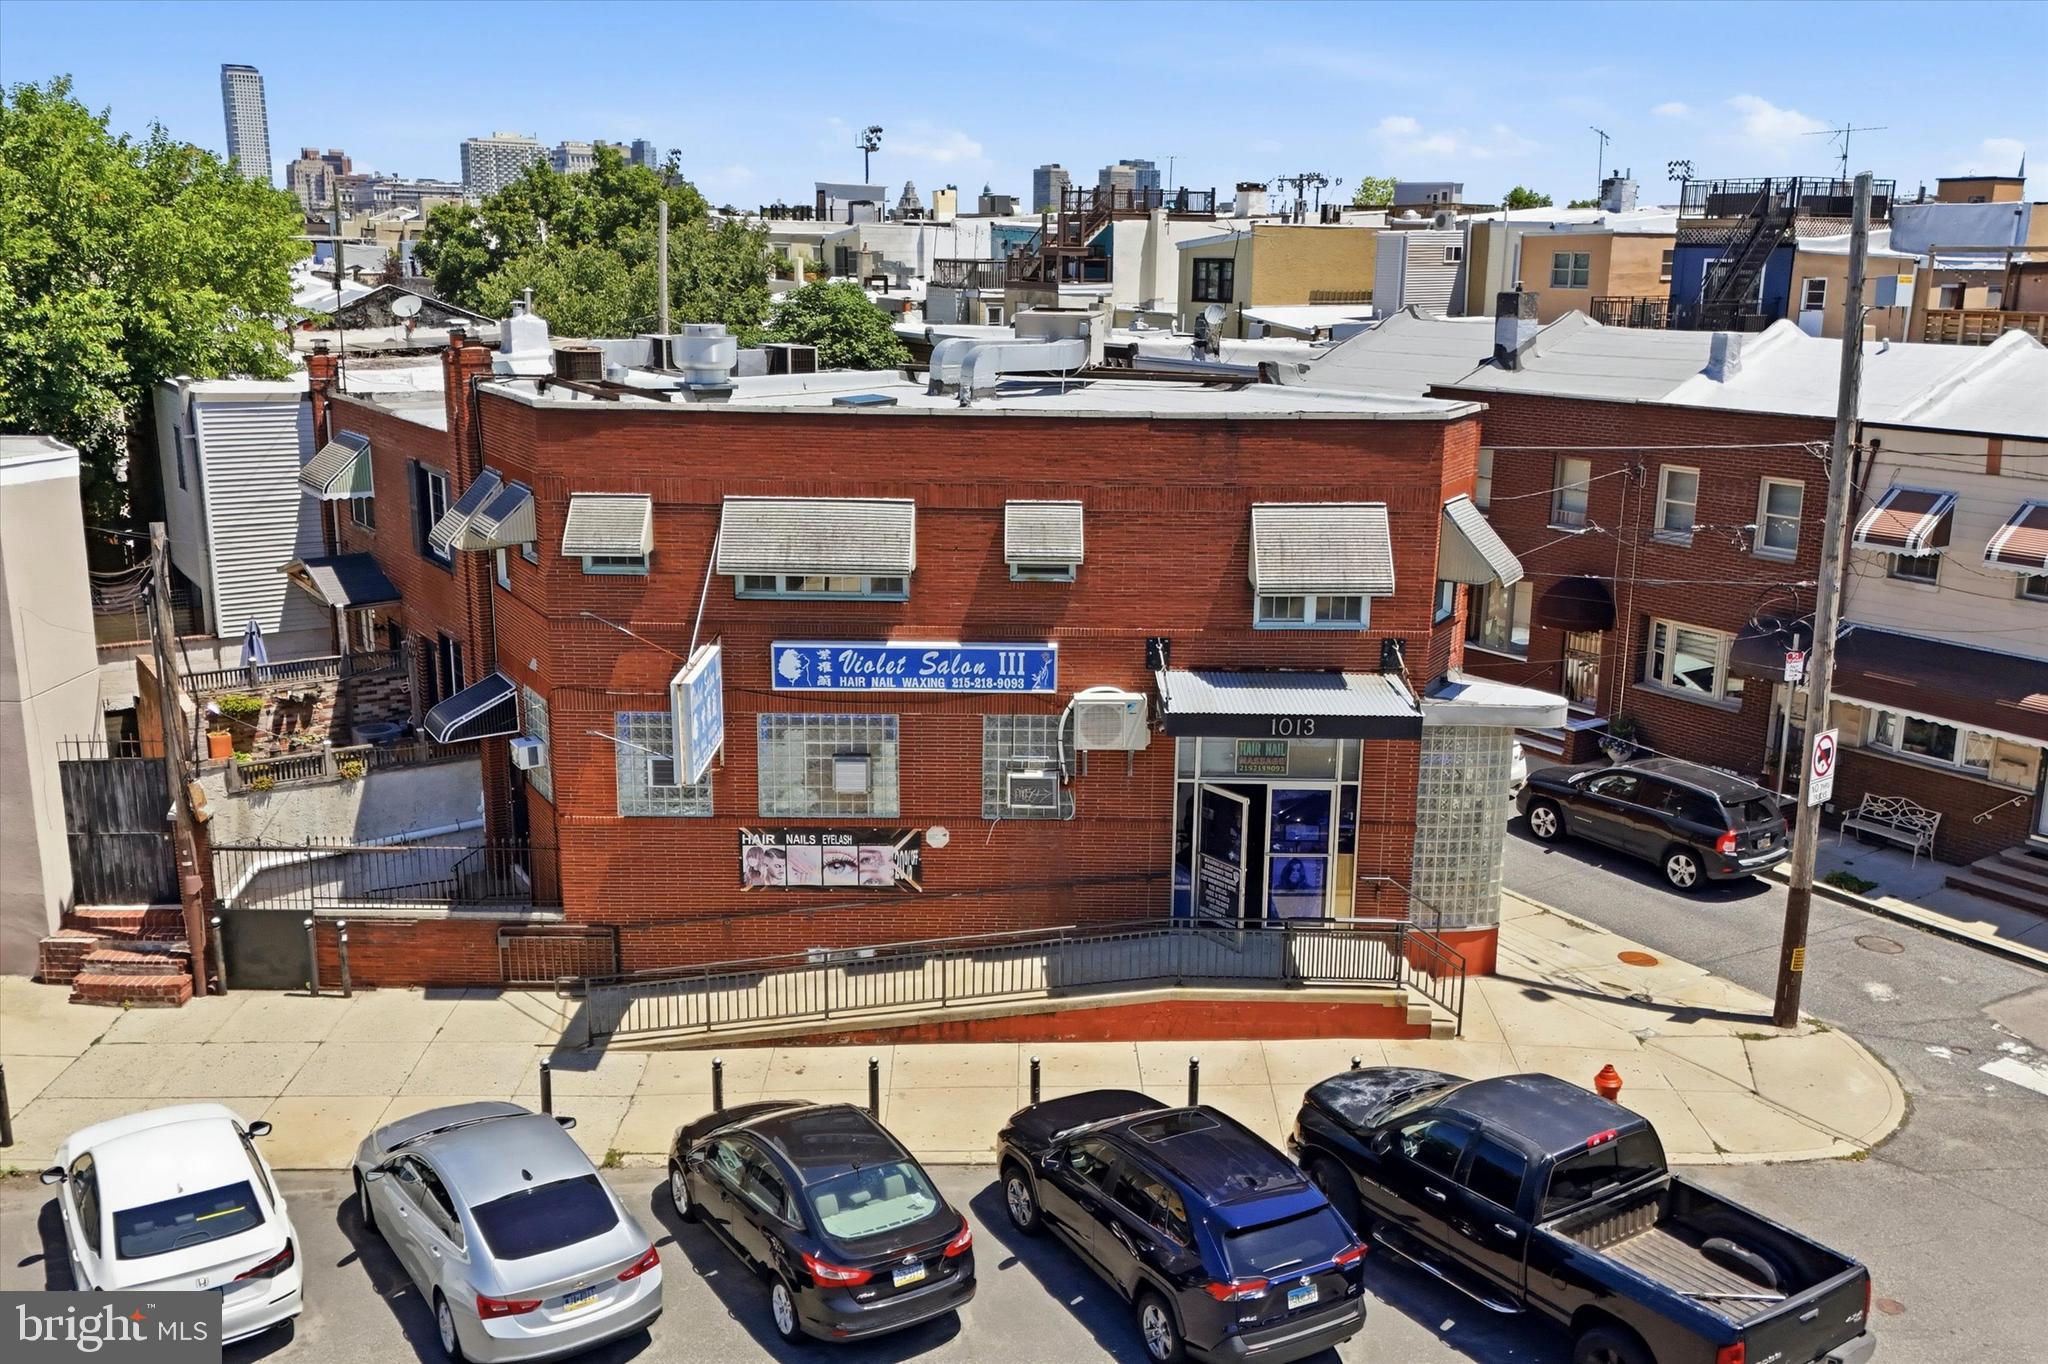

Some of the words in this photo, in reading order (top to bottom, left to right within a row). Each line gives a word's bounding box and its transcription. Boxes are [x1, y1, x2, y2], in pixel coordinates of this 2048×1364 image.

[838, 649, 907, 675] Violet
[919, 650, 986, 676] Salon
[998, 652, 1025, 676] III
[840, 676, 866, 688] HAIR
[871, 677, 897, 688] NAIL
[902, 677, 946, 688] WAXING
[952, 677, 1025, 689] 215-218-9093
[1271, 718, 1315, 736] 1013
[742, 834, 775, 845] HAIR
[786, 834, 816, 845] NAILS
[822, 834, 852, 845] EYELASH
